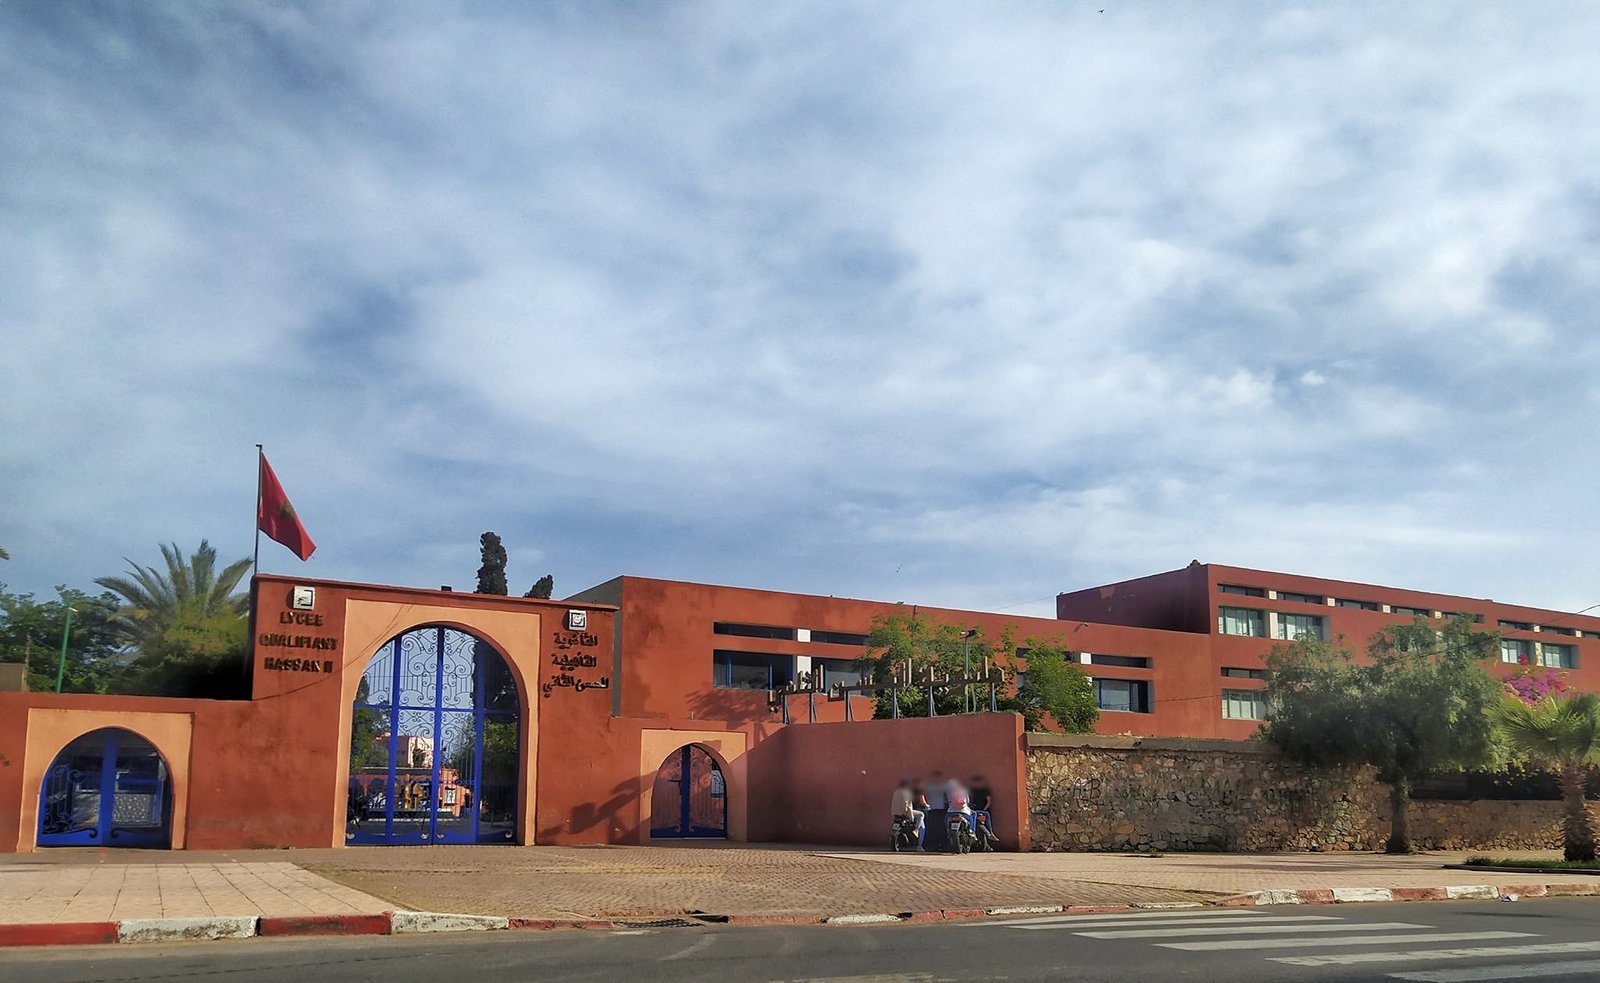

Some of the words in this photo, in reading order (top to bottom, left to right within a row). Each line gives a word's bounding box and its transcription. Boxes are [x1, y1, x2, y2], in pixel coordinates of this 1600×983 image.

[260, 633, 338, 650] QUALIFIANT
[264, 657, 321, 672] HASSAN
[323, 661, 333, 673] II
[543, 673, 575, 698] الثاني
[575, 677, 609, 692] الحسن
